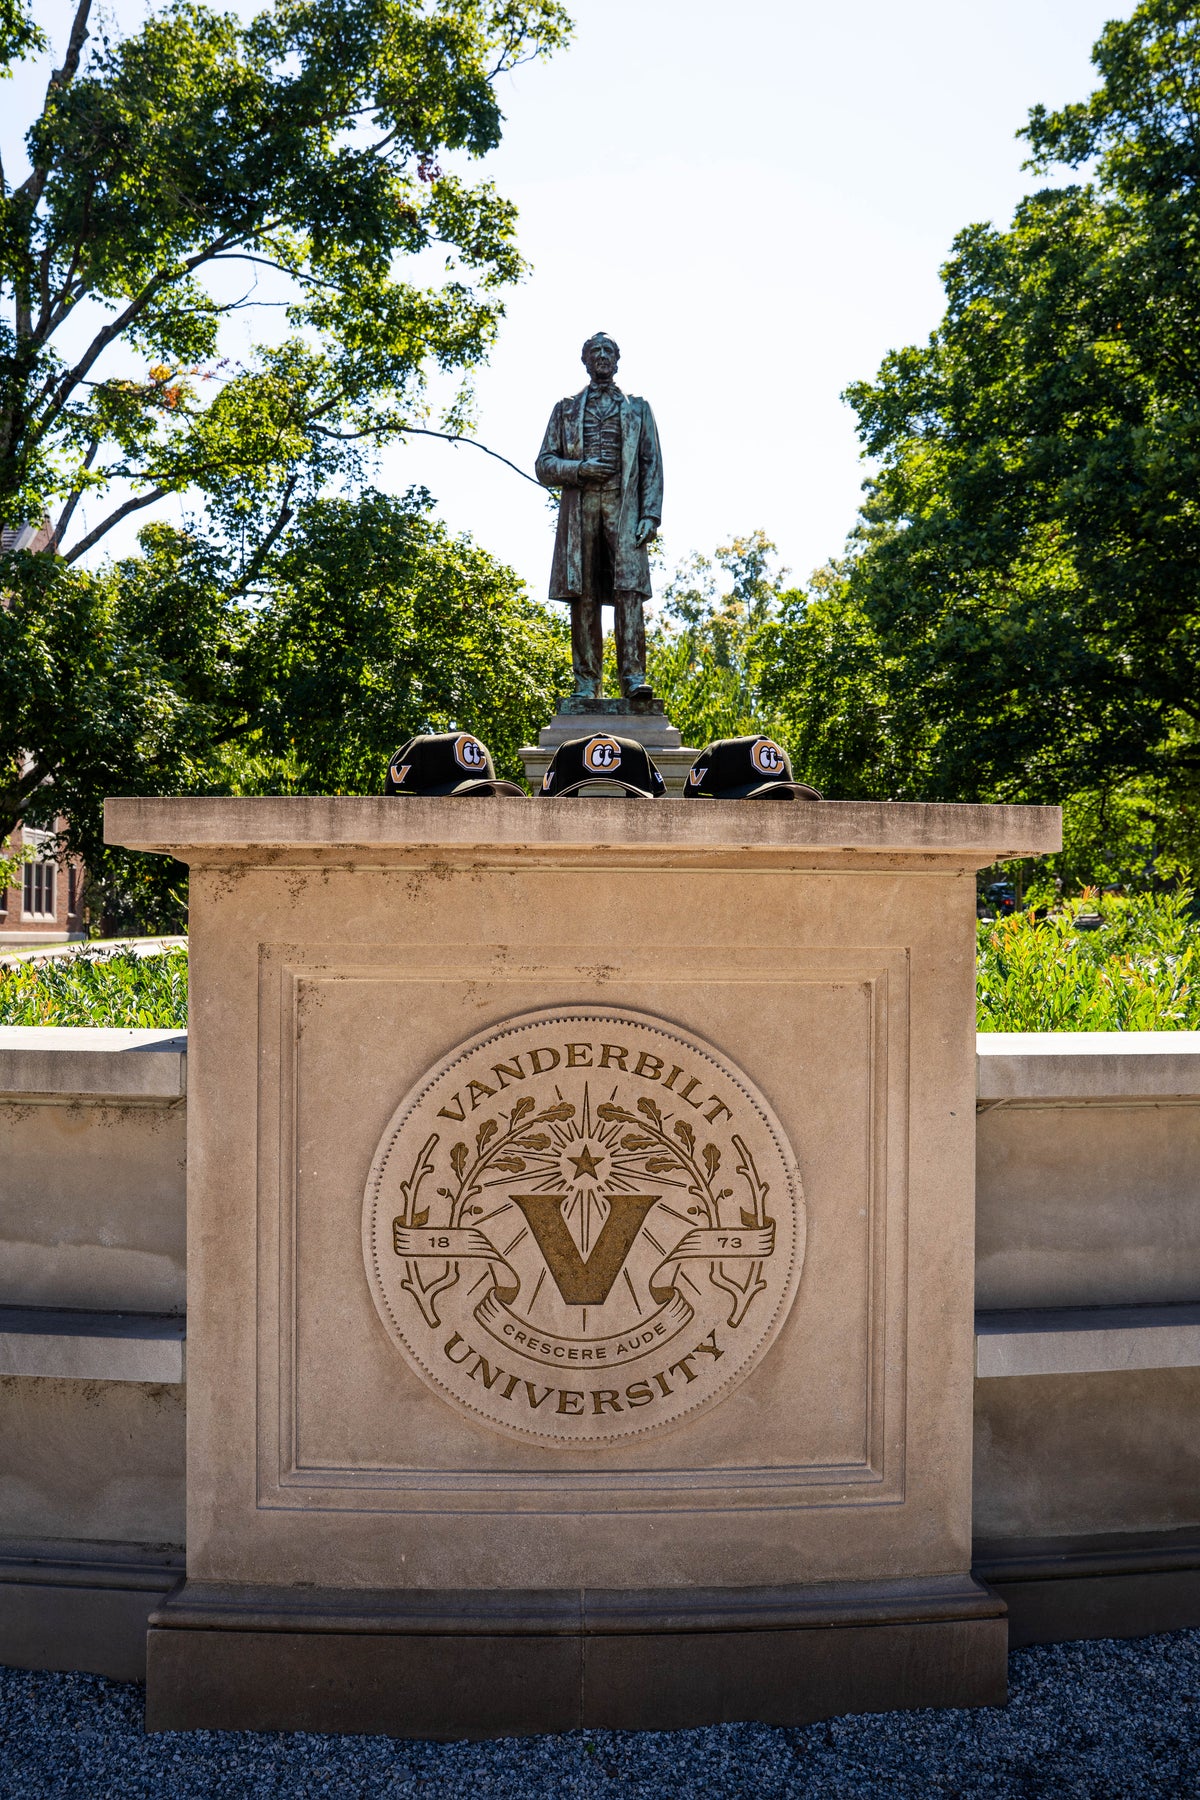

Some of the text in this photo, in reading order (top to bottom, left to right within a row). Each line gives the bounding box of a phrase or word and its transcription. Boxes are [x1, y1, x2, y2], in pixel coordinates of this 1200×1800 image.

[390, 764, 412, 783] V
[543, 771, 555, 790] V
[690, 768, 708, 786] V
[437, 1042, 733, 1125] VANDERBILT
[428, 1236, 451, 1249] 18
[508, 1194, 663, 1306] V
[717, 1236, 743, 1249] 73
[502, 1322, 667, 1360] CRESCERE AUDE
[443, 1329, 726, 1416] UNIVERSITY
